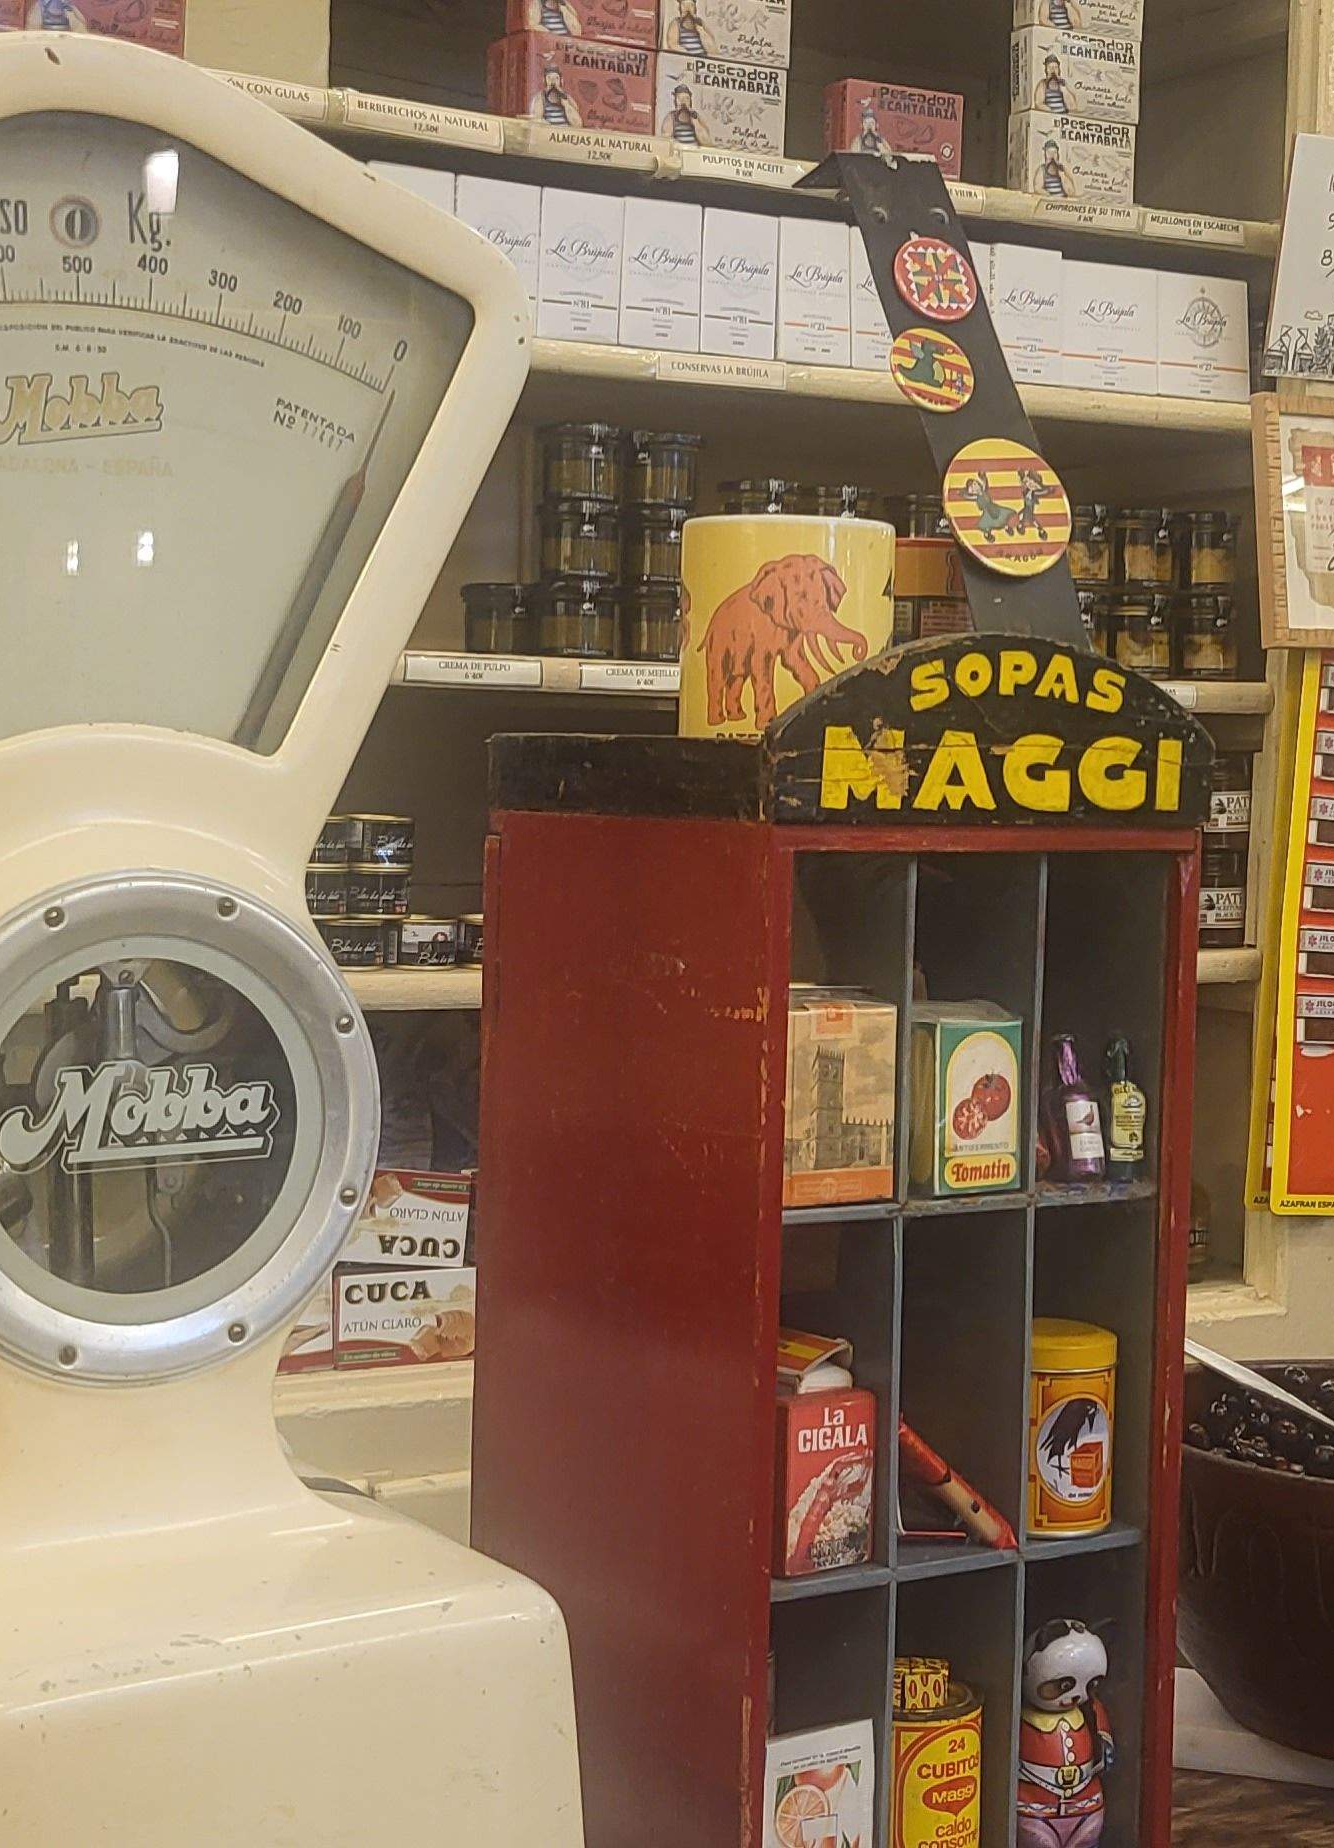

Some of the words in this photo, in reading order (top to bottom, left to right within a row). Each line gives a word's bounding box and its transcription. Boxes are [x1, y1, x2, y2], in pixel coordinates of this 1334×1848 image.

[1069, 46, 1136, 65] CANTABRIA
[246, 80, 273, 95] CON
[275, 86, 310, 102] GULAS
[703, 75, 781, 98] CANTABRIA
[430, 111, 442, 123] AL
[444, 114, 490, 133] NATURAL
[886, 101, 958, 122] CANTABRIA
[548, 131, 592, 147] ALMEJAS
[593, 137, 606, 149] AL
[608, 139, 653, 154] NATURAL
[1068, 130, 1132, 149] CANTABRIA
[702, 154, 742, 168] PULPITOS
[744, 159, 754, 169] EN
[756, 161, 785, 175] ACEITE
[127, 190, 172, 252] Kg.
[1045, 202, 1087, 215] CHIPIRONES
[1110, 208, 1131, 219] TINTA
[1150, 214, 1191, 228] MEJILLONES
[1203, 220, 1240, 234] ESCABECHE
[62, 256, 92, 274] 500
[137, 254, 168, 276] 400
[1320, 249, 1334, 267] 8
[208, 270, 238, 293] 300
[273, 291, 303, 316] 200
[337, 314, 361, 341] 100
[393, 339, 408, 362] 0
[671, 361, 721, 376] CONSERVAS
[723, 365, 735, 376] LA
[275, 397, 356, 444] PATENTADA
[438, 661, 469, 672] CREMA
[470, 662, 482, 672] DE
[483, 662, 511, 673] PULPO
[605, 667, 634, 678] CREMA
[635, 668, 647, 678] DE
[647, 669, 679, 680] MEJILLO
[910, 649, 1127, 714] SOPAS
[820, 725, 1184, 813] MAGGI
[378, 1234, 462, 1260] CUCA
[344, 1279, 432, 1305] CUCA
[343, 1318, 379, 1333] ATÚN
[381, 1316, 422, 1331] CLARO
[823, 1406, 845, 1426] La
[798, 1424, 868, 1454] CIGALA
[948, 1736, 966, 1754] 24
[917, 1754, 980, 1780] CUBITOS
[935, 1816, 972, 1837] caldo
